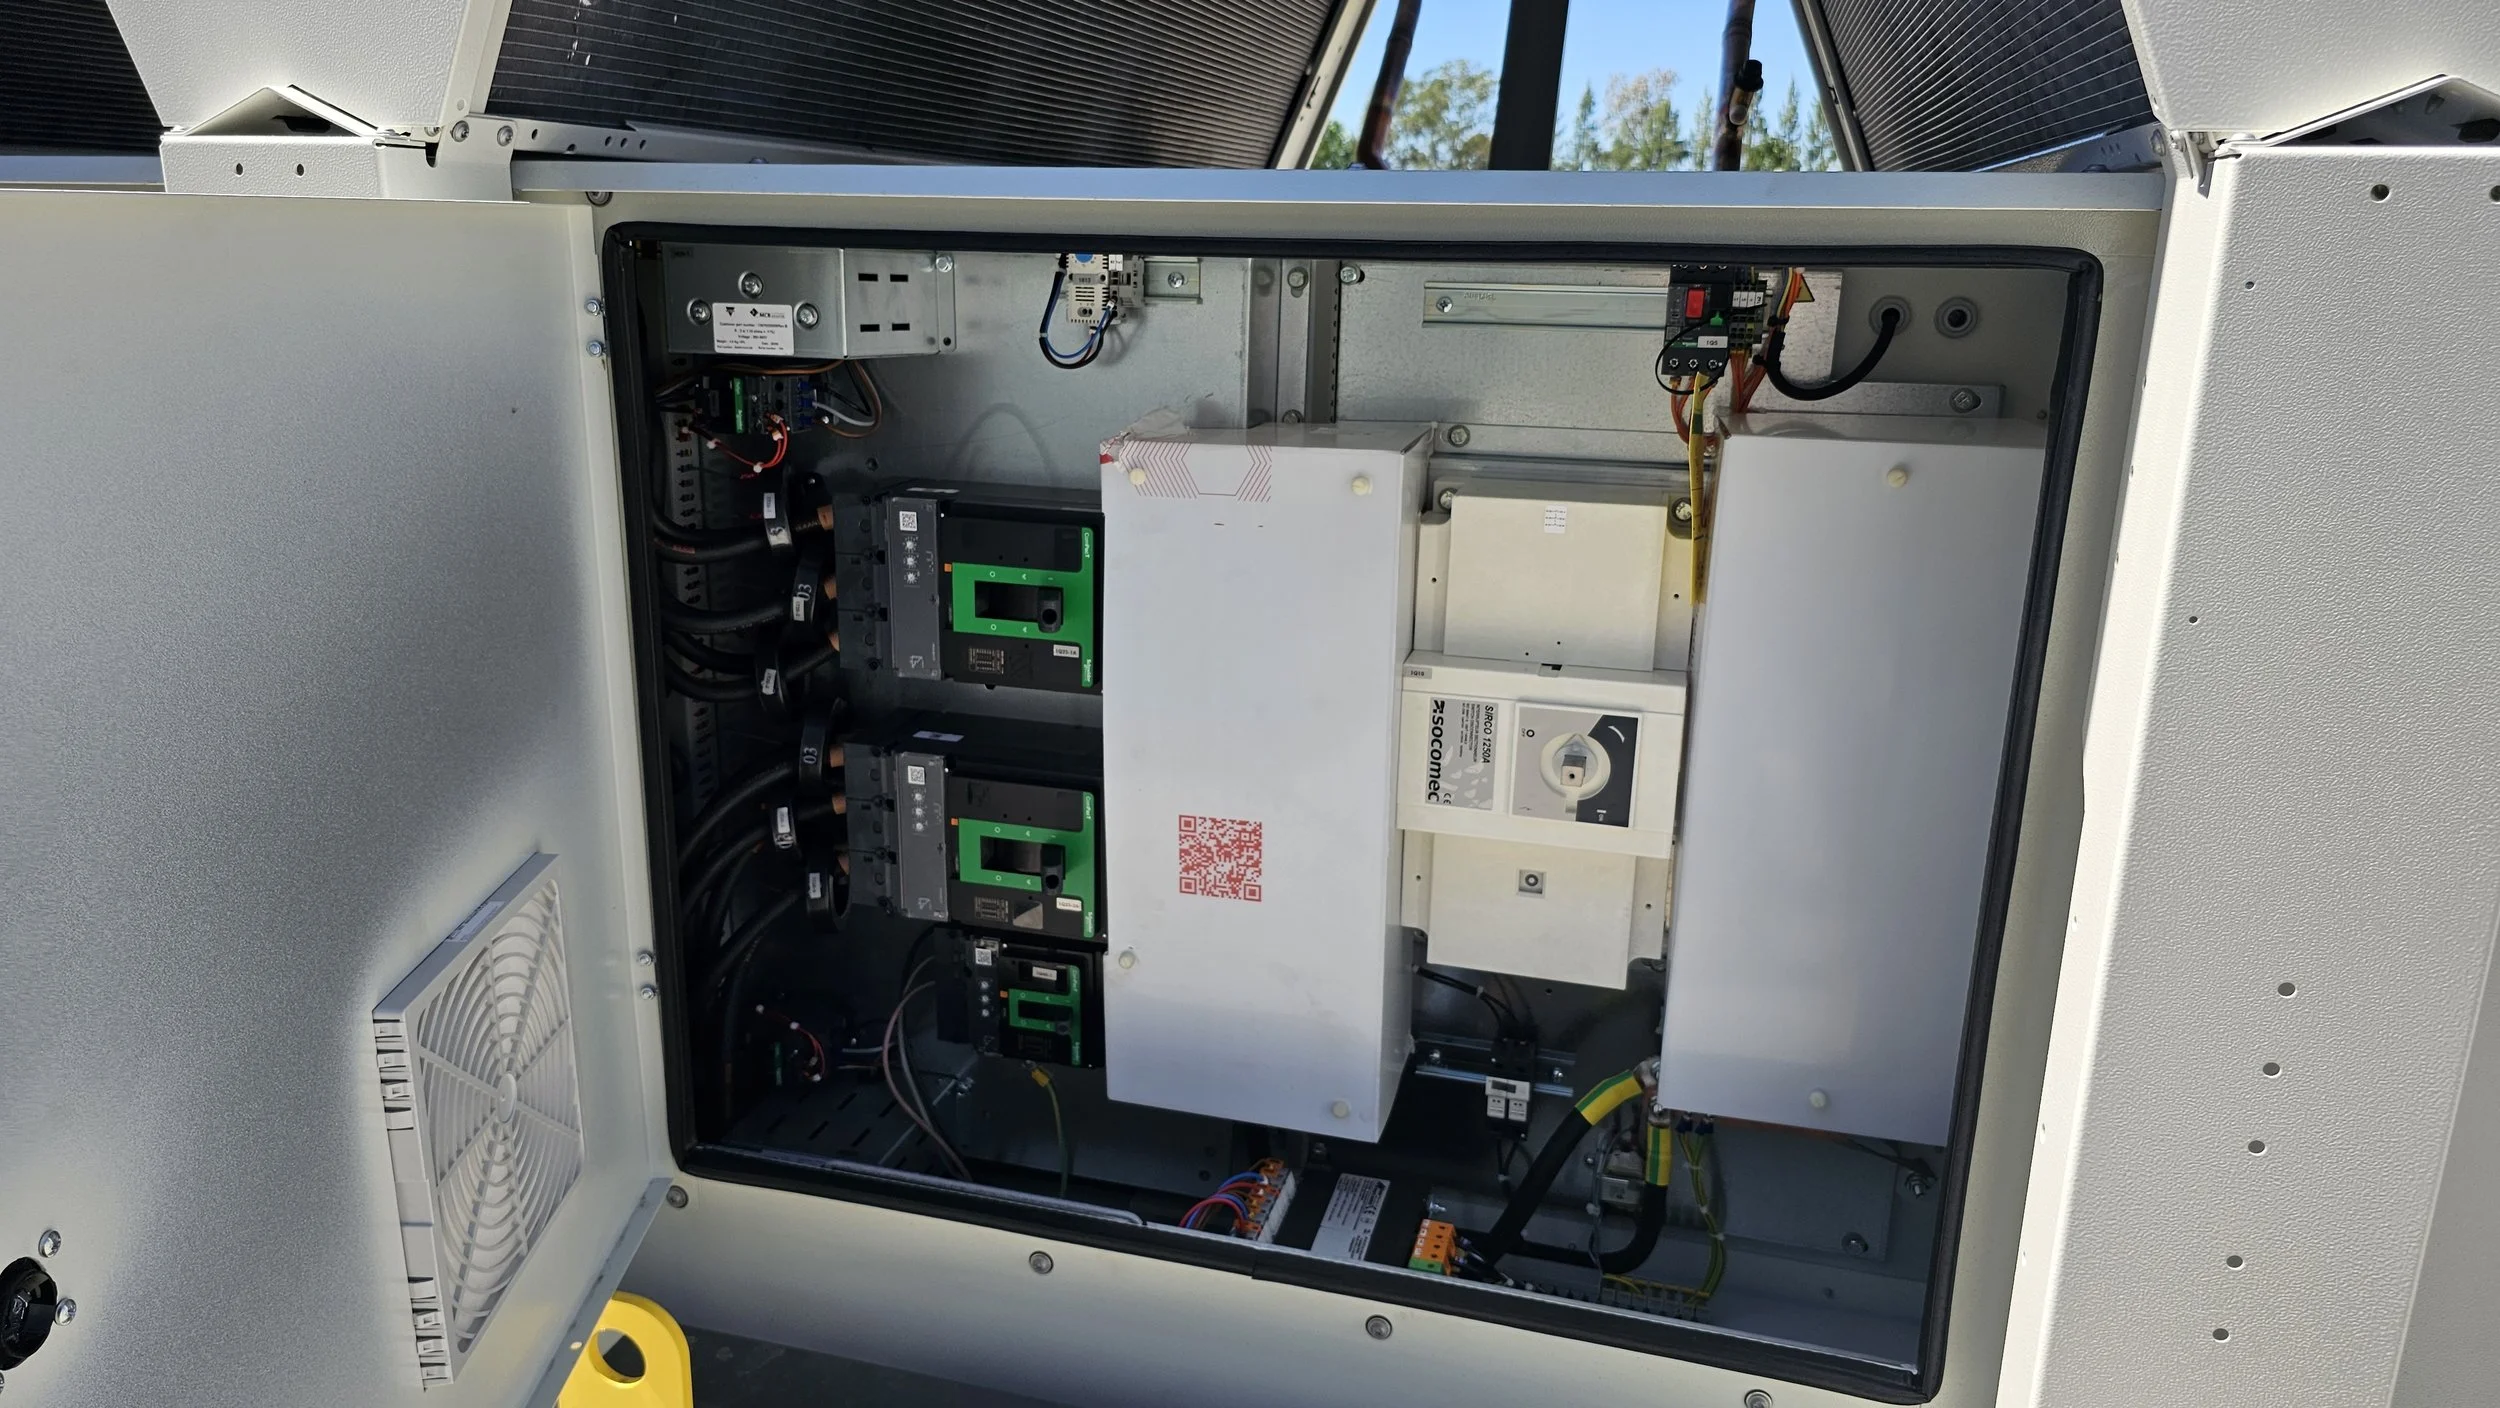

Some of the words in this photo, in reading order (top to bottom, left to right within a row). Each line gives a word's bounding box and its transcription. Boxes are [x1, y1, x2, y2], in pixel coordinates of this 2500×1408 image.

[1484, 705, 1494, 735] SIRCO
[802, 747, 818, 765] 03
[1428, 715, 1443, 802] socomec
[1482, 737, 1491, 764] 1250A
